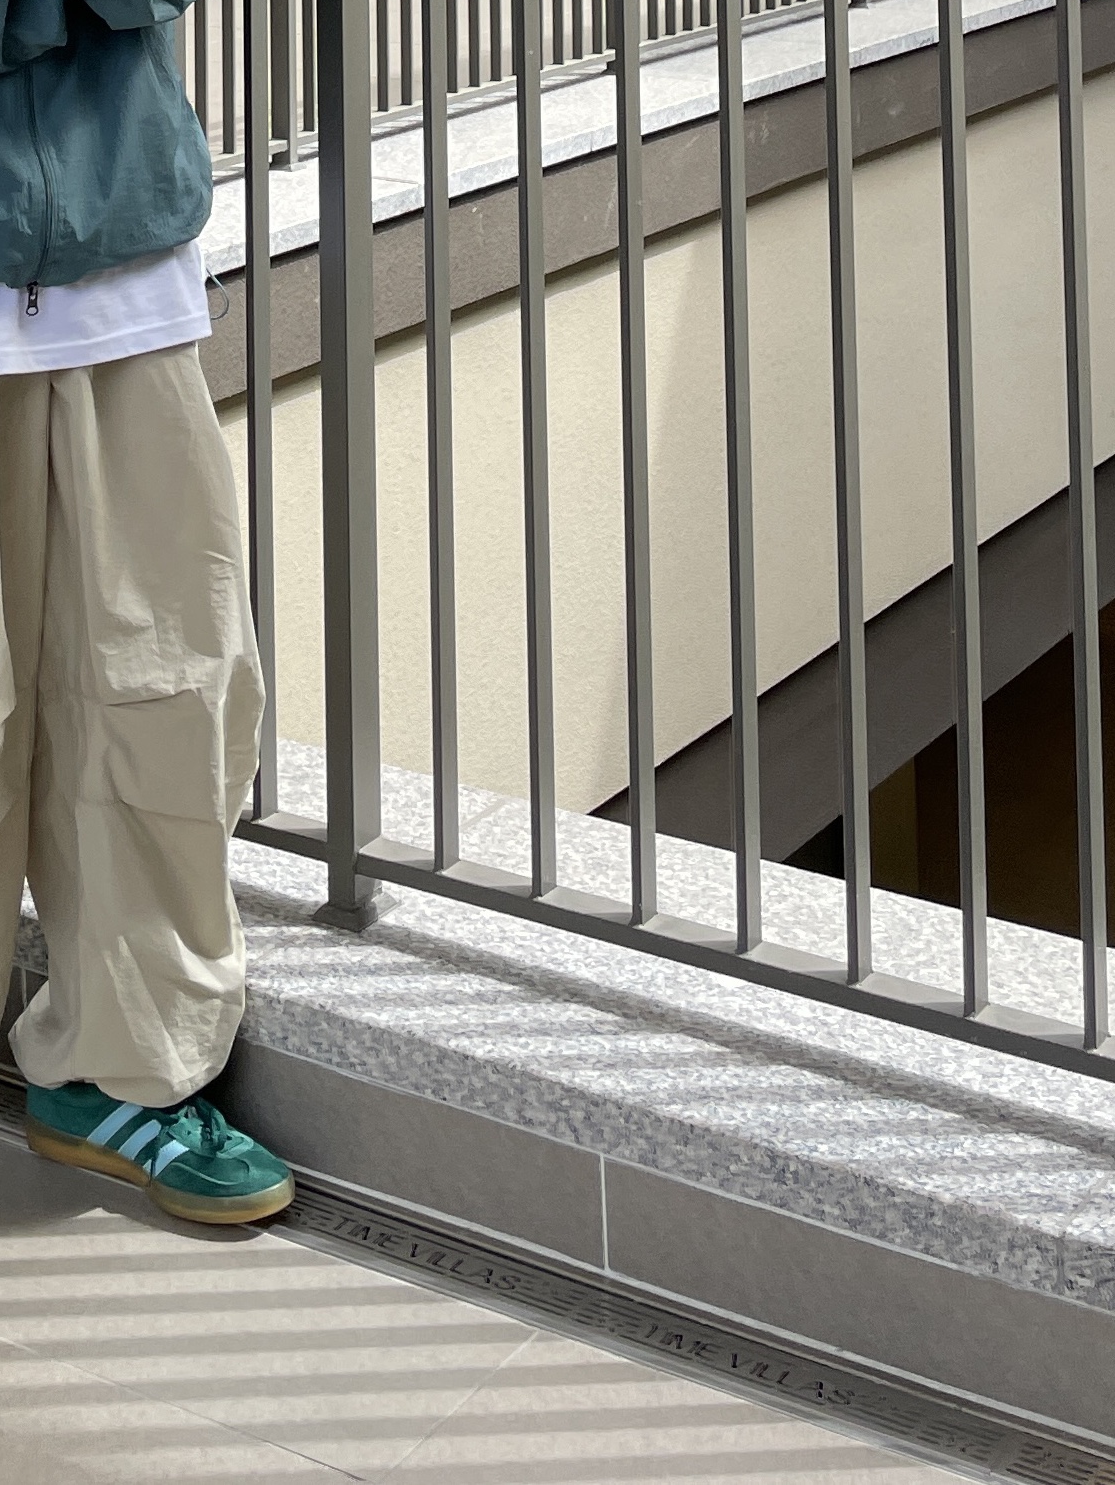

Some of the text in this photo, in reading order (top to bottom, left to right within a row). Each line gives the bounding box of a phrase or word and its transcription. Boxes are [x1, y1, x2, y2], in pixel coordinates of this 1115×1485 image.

[334, 1217, 521, 1290] TIME VILLAS
[645, 1324, 855, 1405] TIME VILLAS
